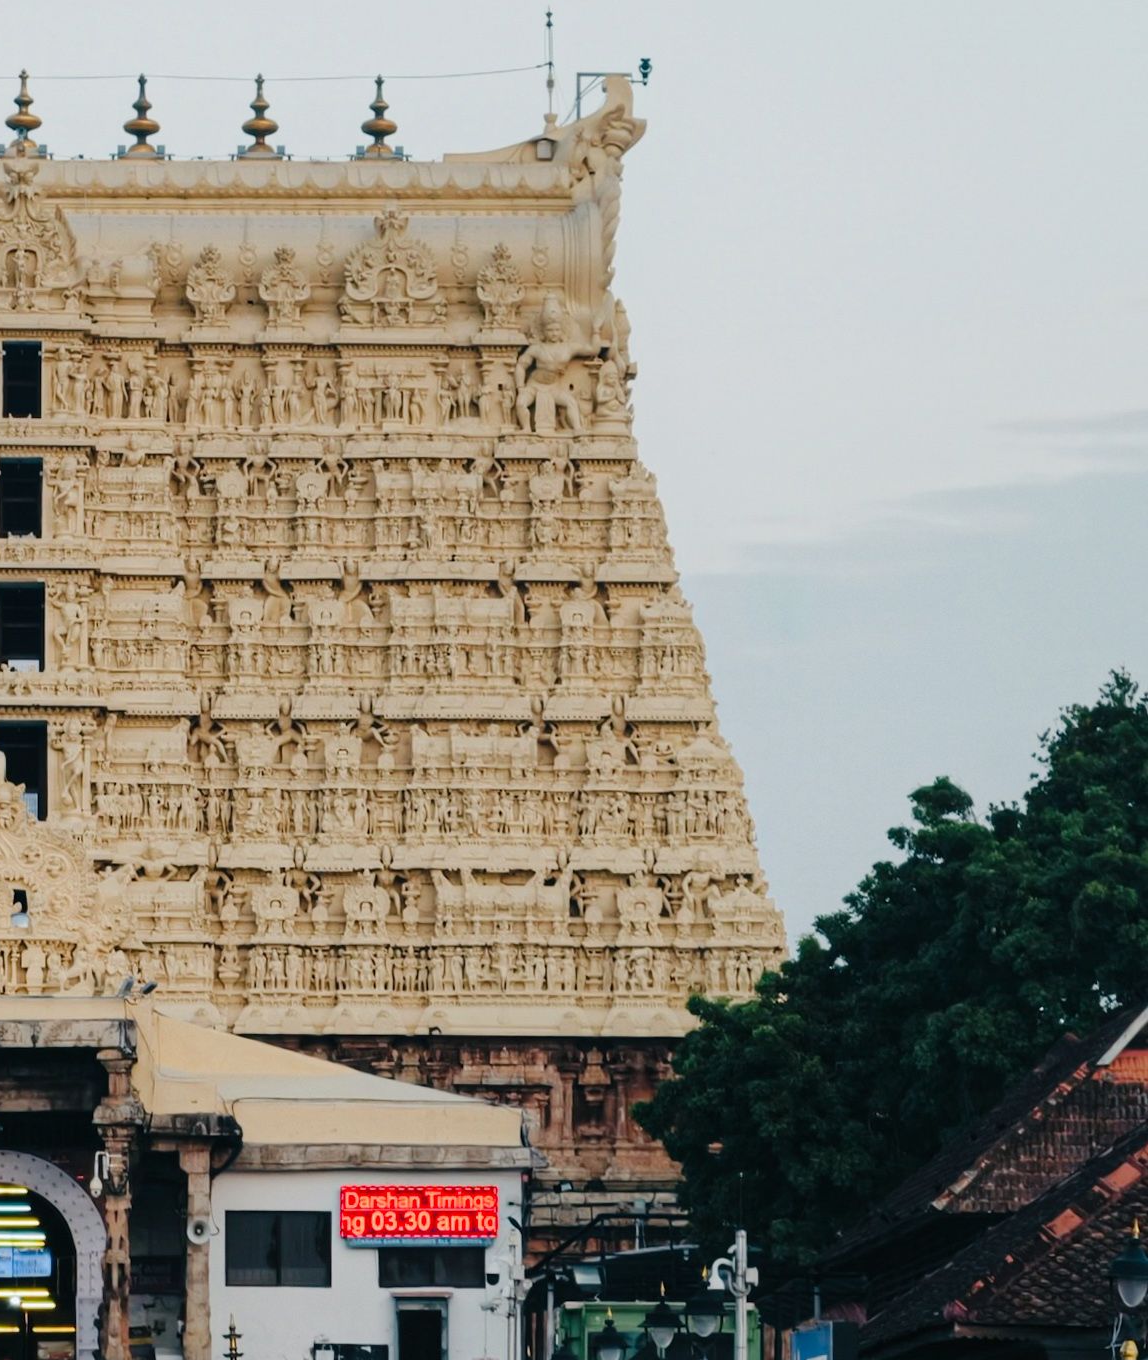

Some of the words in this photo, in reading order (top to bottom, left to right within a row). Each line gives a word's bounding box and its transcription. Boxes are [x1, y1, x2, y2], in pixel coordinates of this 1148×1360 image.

[345, 1191, 421, 1209] Darshan
[425, 1191, 495, 1210] Timings
[371, 1211, 431, 1231] 03.30
[437, 1215, 470, 1231] am
